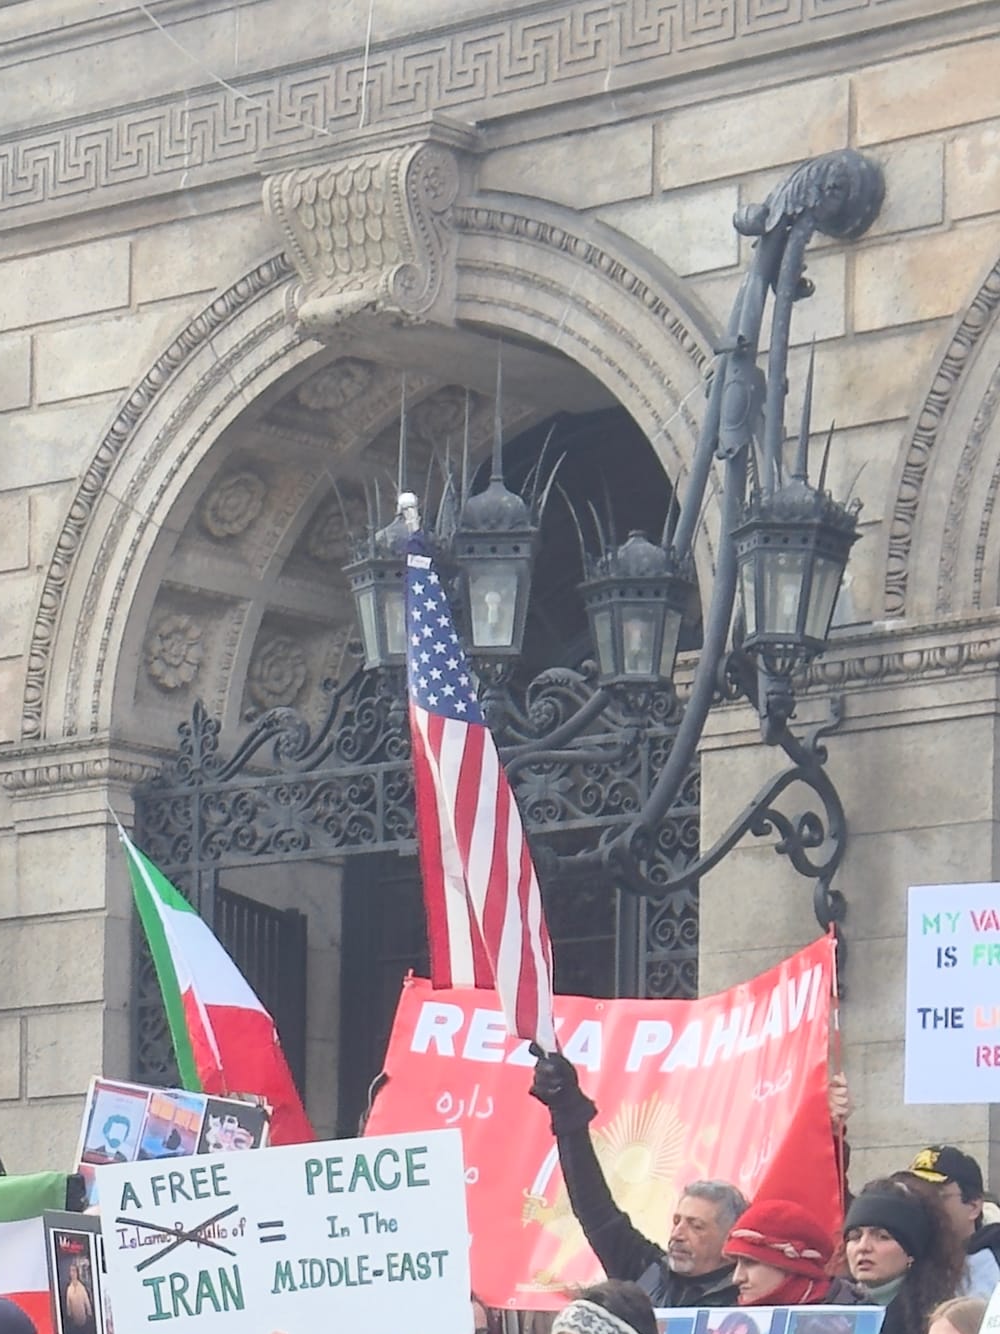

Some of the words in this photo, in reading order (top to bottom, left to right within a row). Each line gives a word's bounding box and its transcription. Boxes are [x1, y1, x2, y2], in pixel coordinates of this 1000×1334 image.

[922, 911, 961, 935] MY
[937, 946, 958, 968] IS
[625, 964, 822, 1072] PAHLAVI
[917, 1006, 964, 1030] THE
[120, 1182, 143, 1211] A
[150, 1163, 232, 1206] FREE
[305, 1146, 430, 1195] PEACE
[232, 1217, 247, 1237] of
[326, 1215, 350, 1238] In
[358, 1212, 398, 1234] The
[271, 1250, 449, 1294] MIDDLE-EAST
[143, 1264, 245, 1322] IRAN
